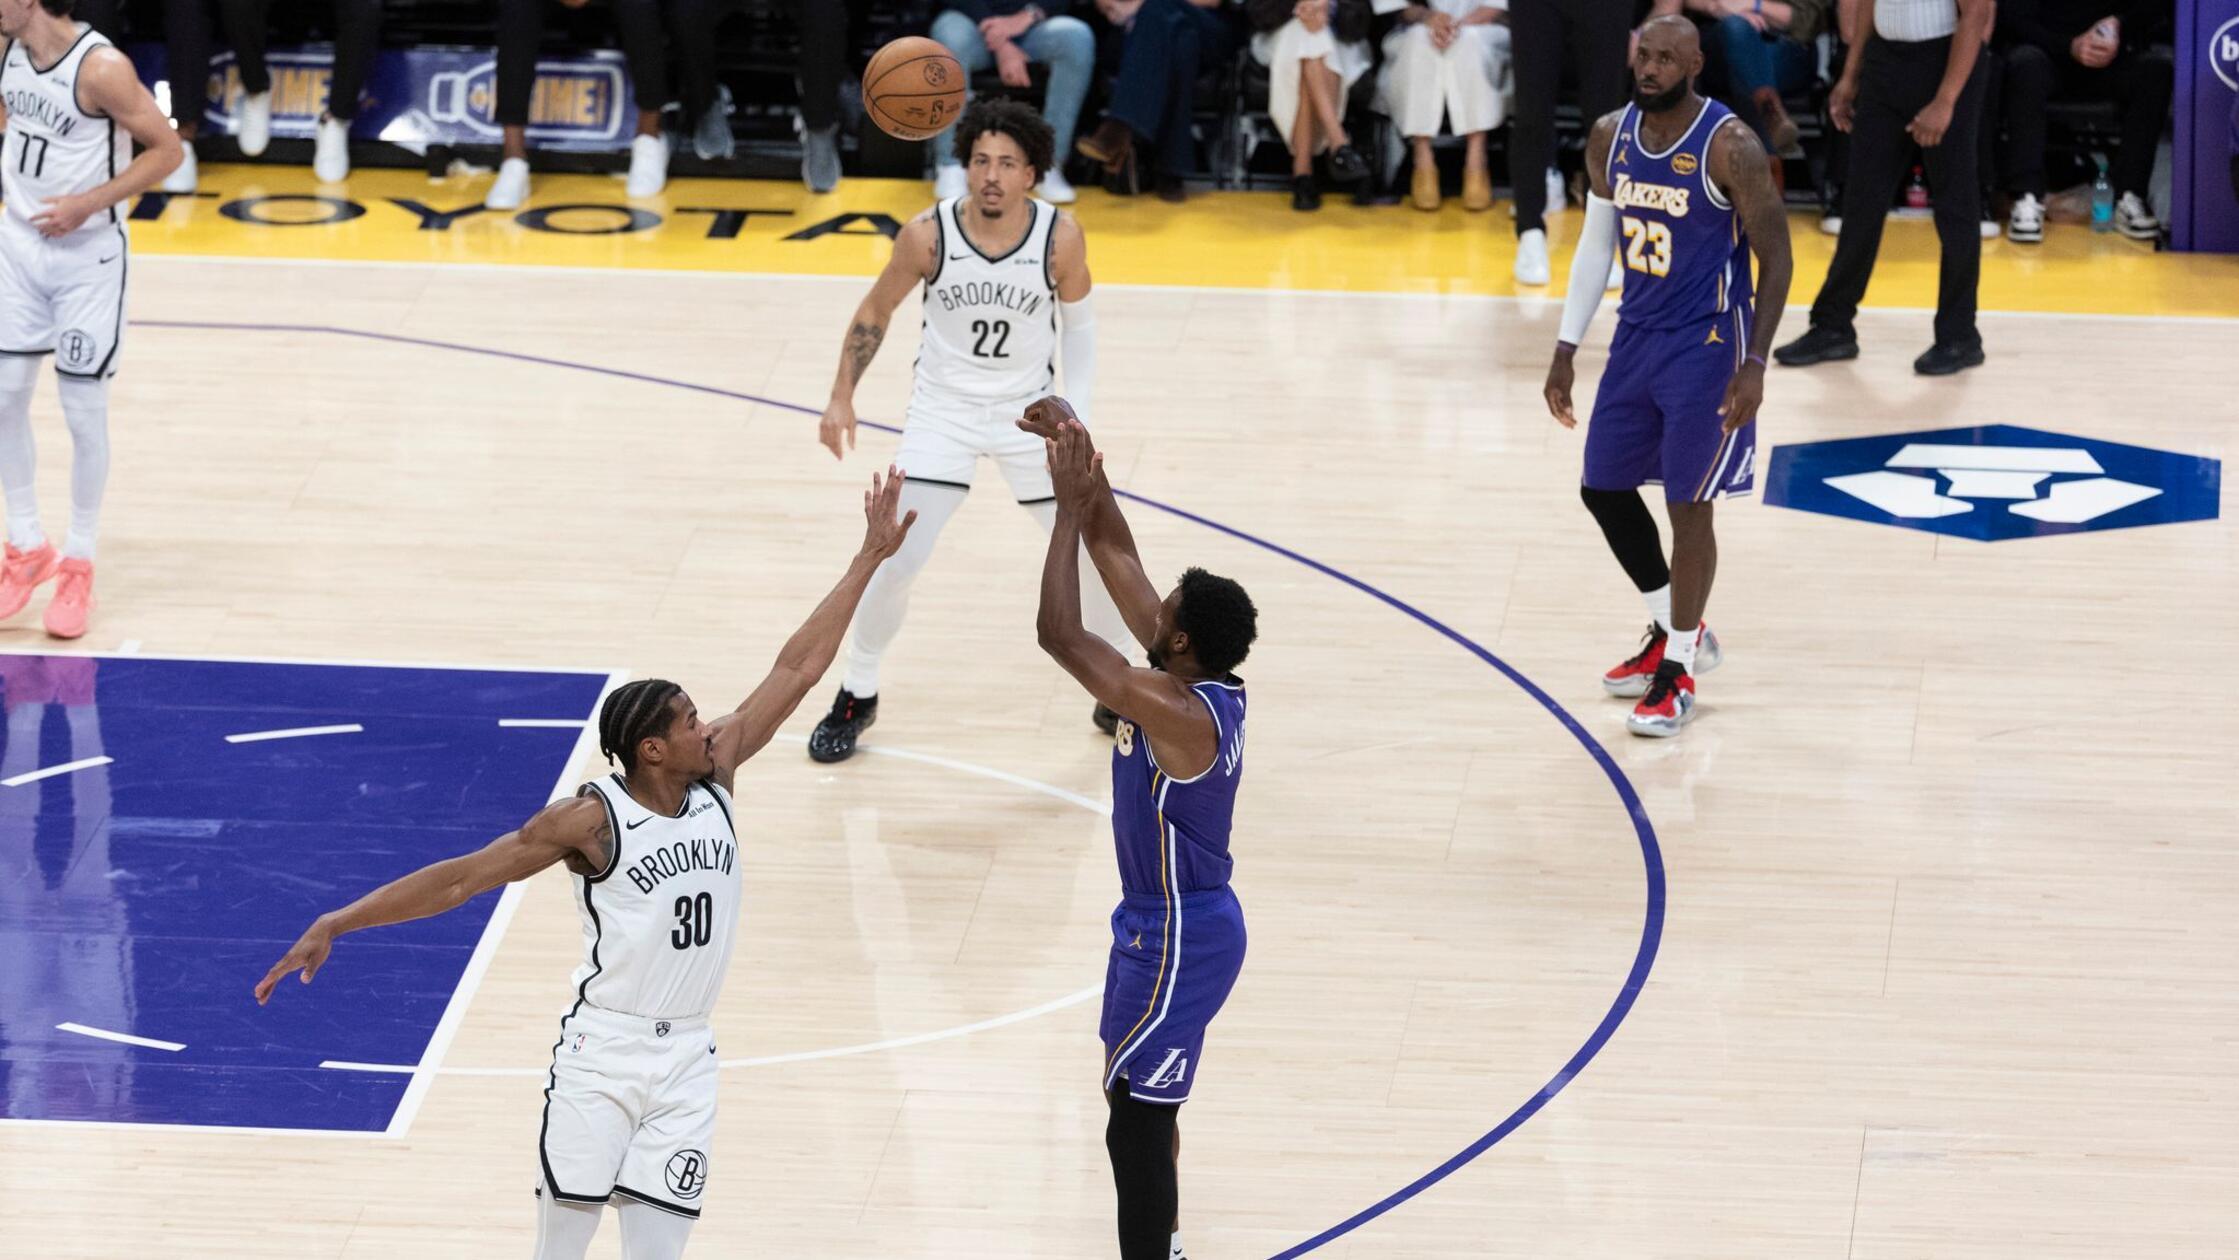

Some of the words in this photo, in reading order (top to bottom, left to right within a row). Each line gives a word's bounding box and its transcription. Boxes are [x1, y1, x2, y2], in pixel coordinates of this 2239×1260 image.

[18, 131, 48, 177] 77
[128, 192, 906, 241] TOYOTA
[1613, 173, 1690, 218] LAKERS
[1621, 215, 1673, 279] 23
[937, 281, 1043, 316] BROOKLYN
[971, 319, 1010, 358] 22
[626, 838, 735, 895] BROOKLYN
[671, 891, 713, 951] 30
[1137, 1047, 1188, 1089] LA
[677, 1156, 699, 1192] B
